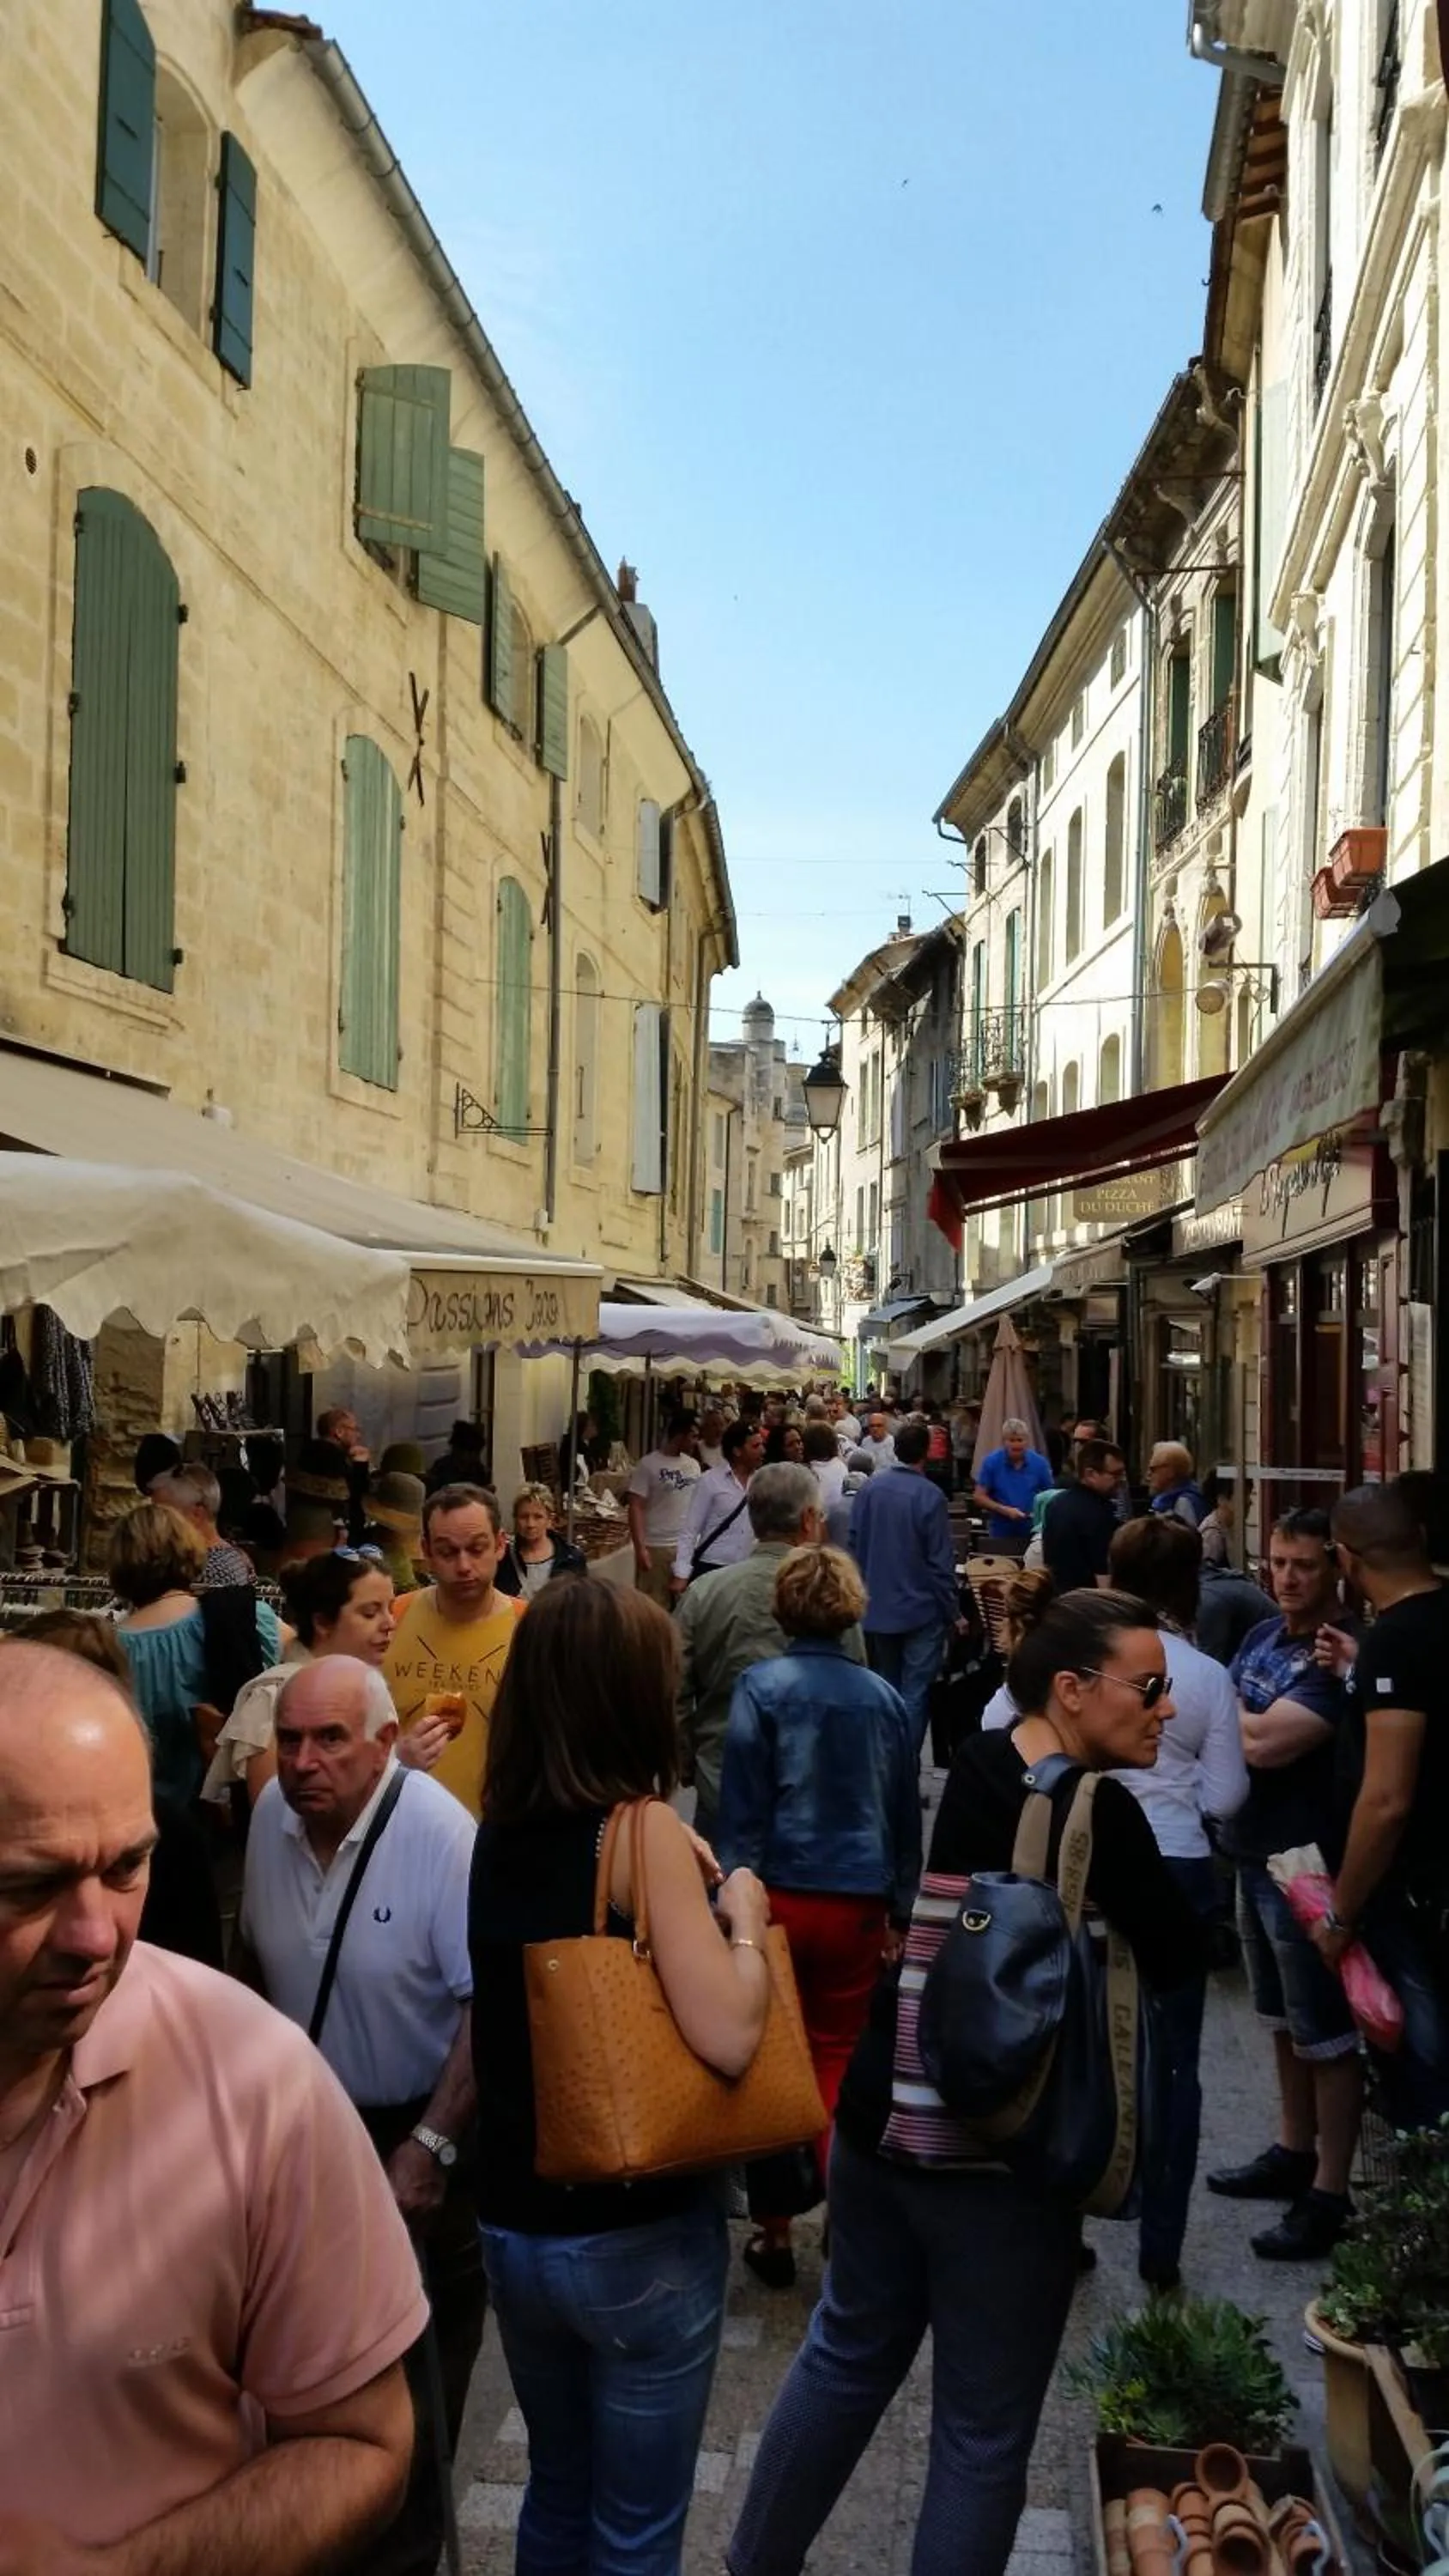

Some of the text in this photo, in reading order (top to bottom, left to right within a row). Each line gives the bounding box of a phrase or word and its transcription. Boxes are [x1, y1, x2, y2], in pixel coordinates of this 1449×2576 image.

[1097, 1188, 1137, 1200] PIZZA
[1081, 1201, 1100, 1213] DU
[394, 1662, 502, 1685] WEEKEN
